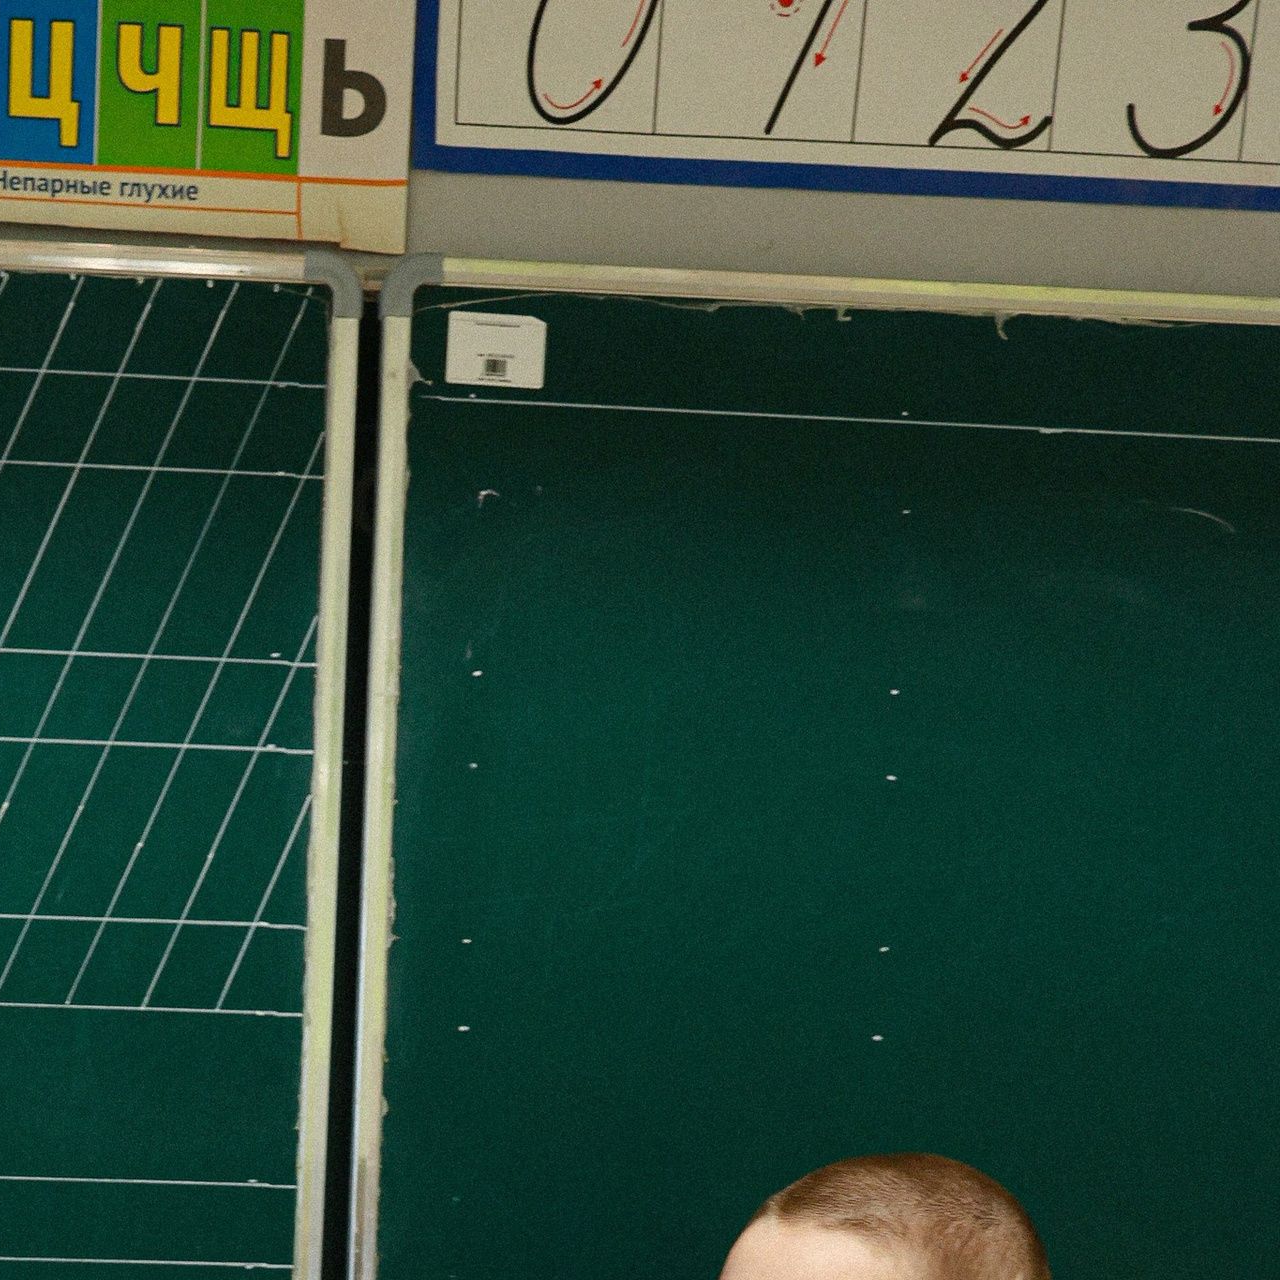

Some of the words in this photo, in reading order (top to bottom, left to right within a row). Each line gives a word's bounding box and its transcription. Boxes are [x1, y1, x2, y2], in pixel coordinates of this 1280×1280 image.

[8, 18, 80, 147] Ц
[118, 22, 183, 126] Ч
[208, 28, 292, 158] Щ
[119, 179, 199, 204] глухие
